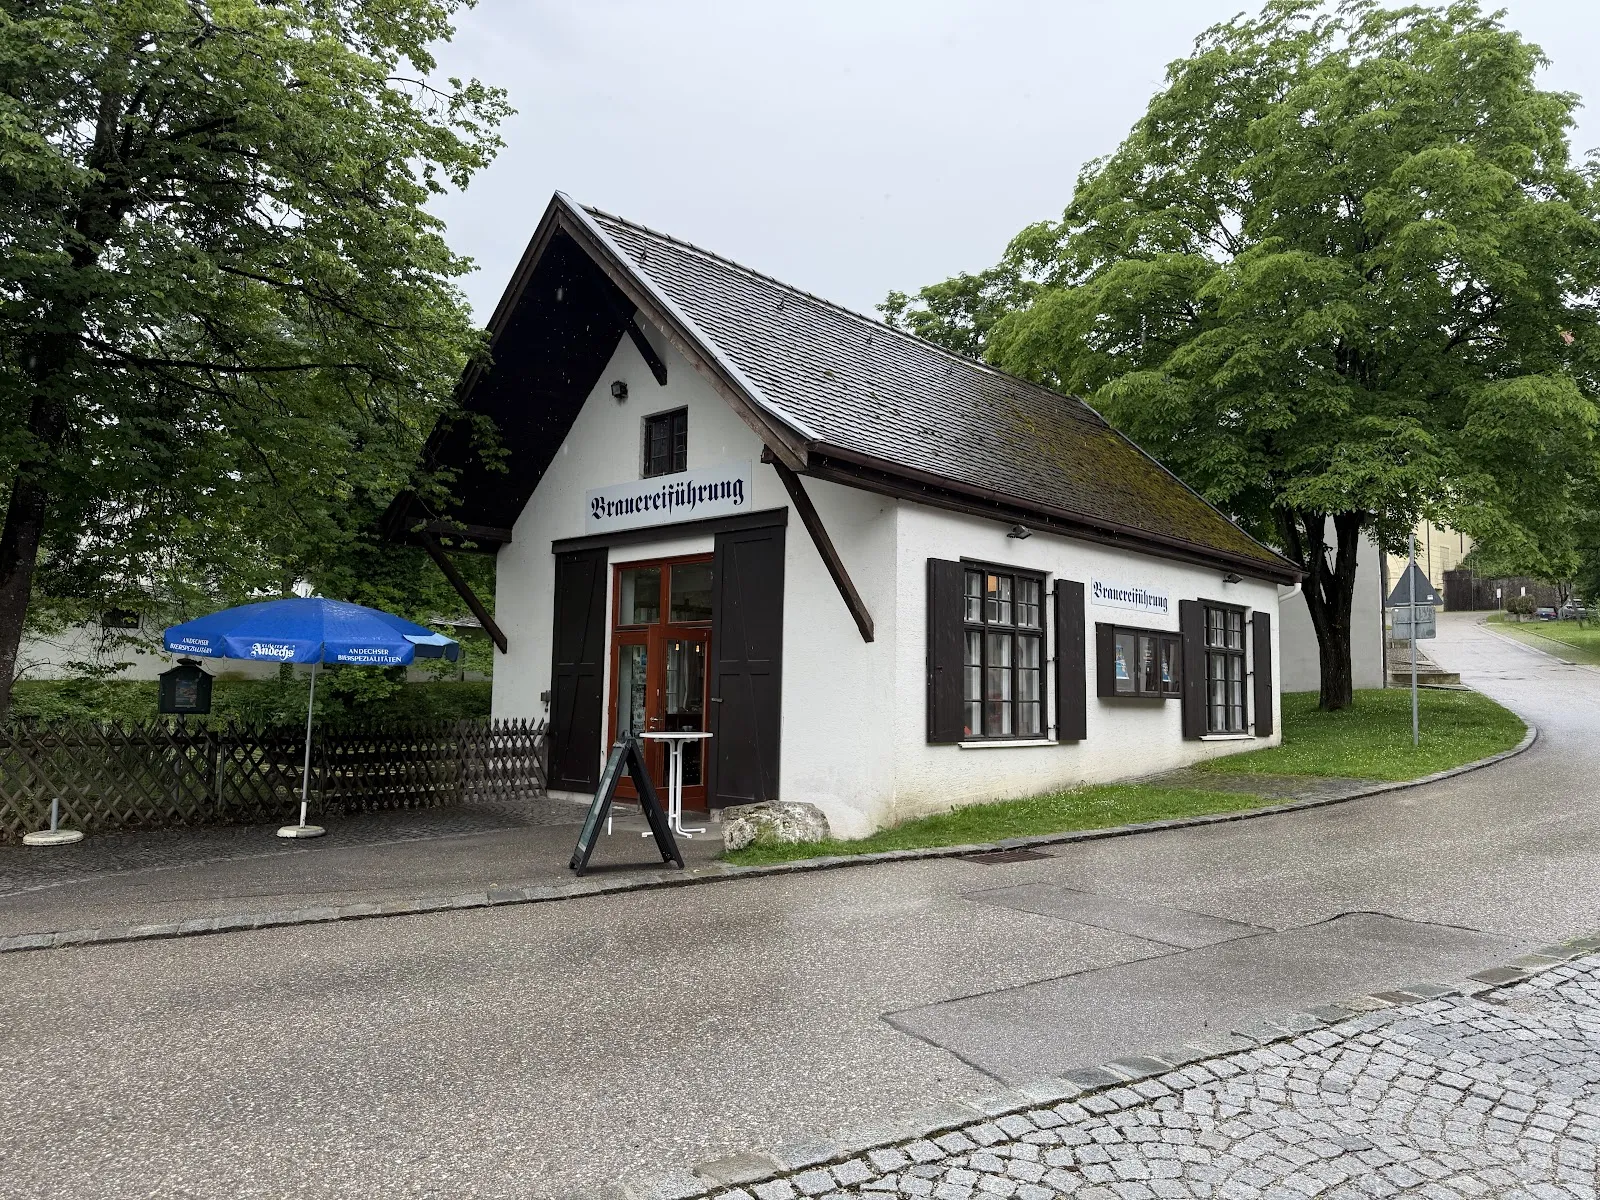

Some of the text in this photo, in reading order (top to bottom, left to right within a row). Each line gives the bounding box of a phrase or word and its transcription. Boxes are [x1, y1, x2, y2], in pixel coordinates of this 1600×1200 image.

[591, 478, 744, 520] Brauereiführung
[1093, 581, 1168, 612] Brauereiführung
[250, 642, 294, 660] Andechs
[337, 654, 402, 663] BIERSPEZIALITÄTEN
